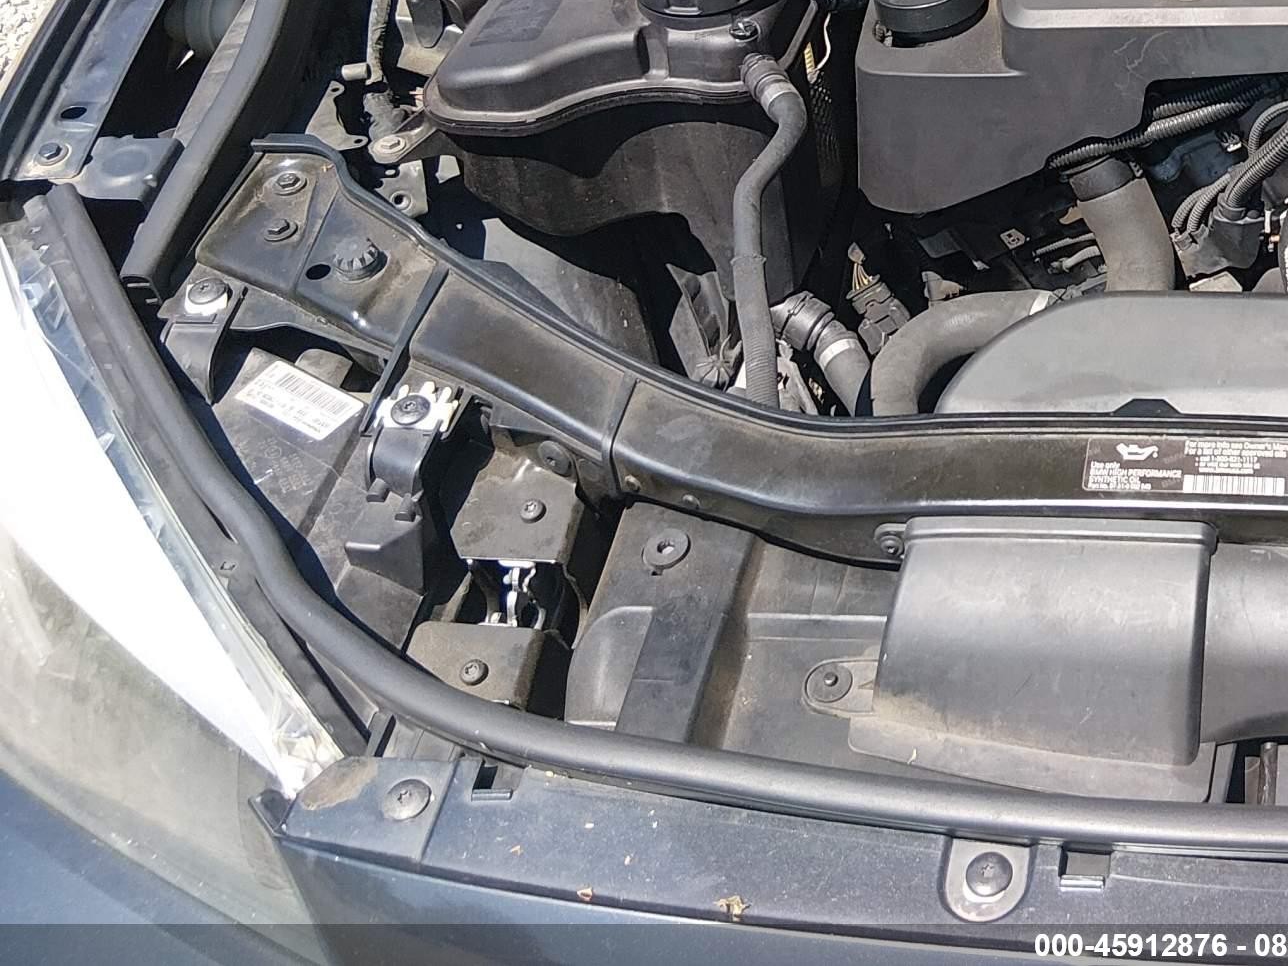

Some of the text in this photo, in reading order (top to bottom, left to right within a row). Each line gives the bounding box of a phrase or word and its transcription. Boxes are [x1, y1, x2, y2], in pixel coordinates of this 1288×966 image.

[1105, 461, 1121, 469] only
[1090, 468, 1182, 478] BMW HIGH PERFORMANCE
[1089, 475, 1128, 483] SYNTHETIC
